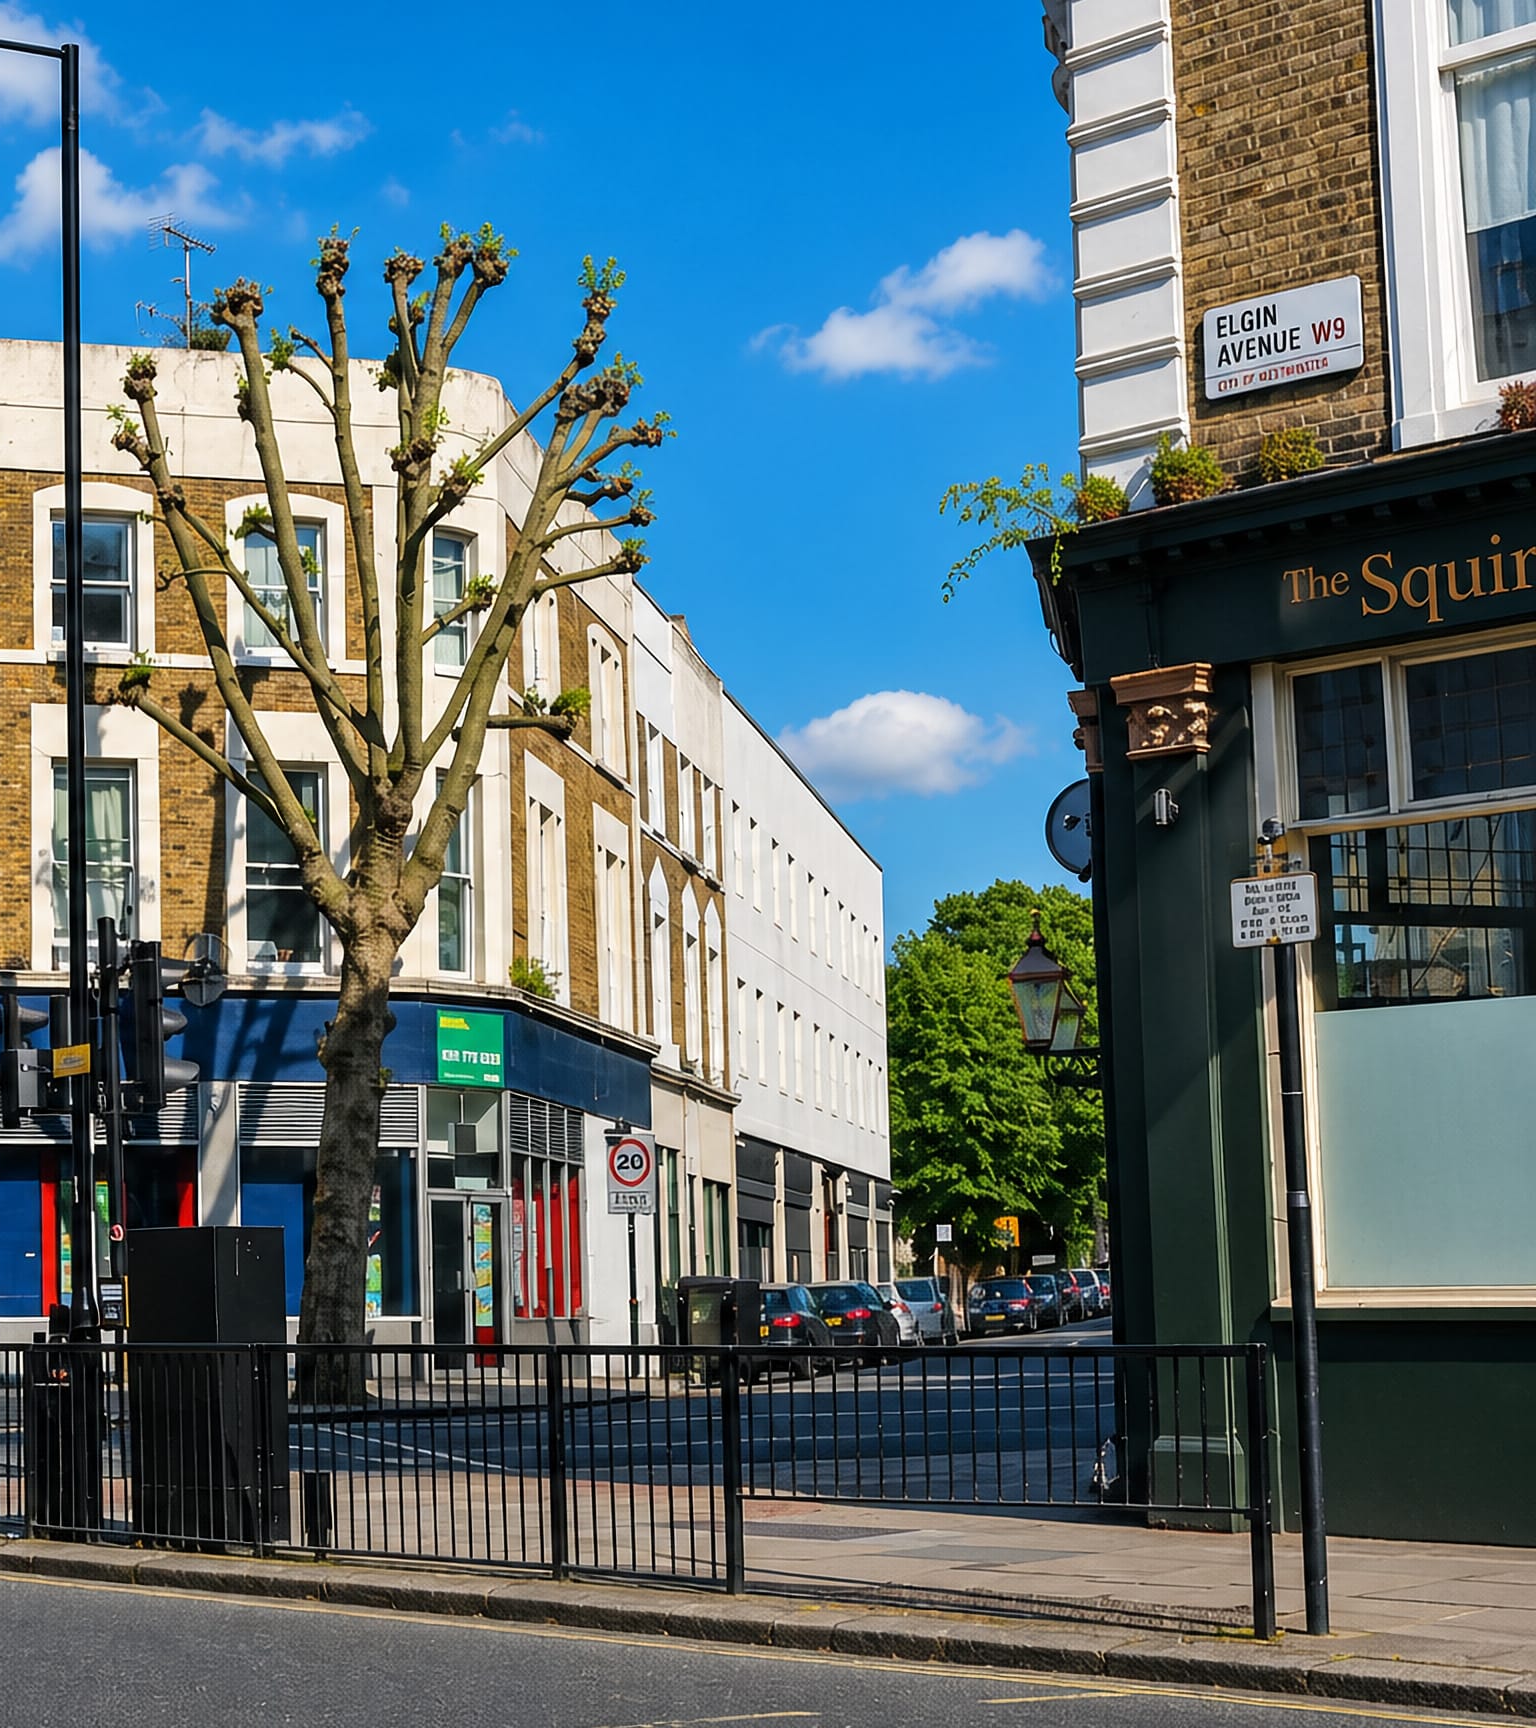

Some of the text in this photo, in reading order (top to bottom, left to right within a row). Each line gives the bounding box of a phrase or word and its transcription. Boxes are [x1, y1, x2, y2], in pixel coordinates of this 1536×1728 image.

[1216, 303, 1277, 339] ELGIN
[1217, 316, 1345, 368] AVENUE W9
[1282, 533, 1536, 624] The Squir
[616, 1153, 644, 1170] 20
